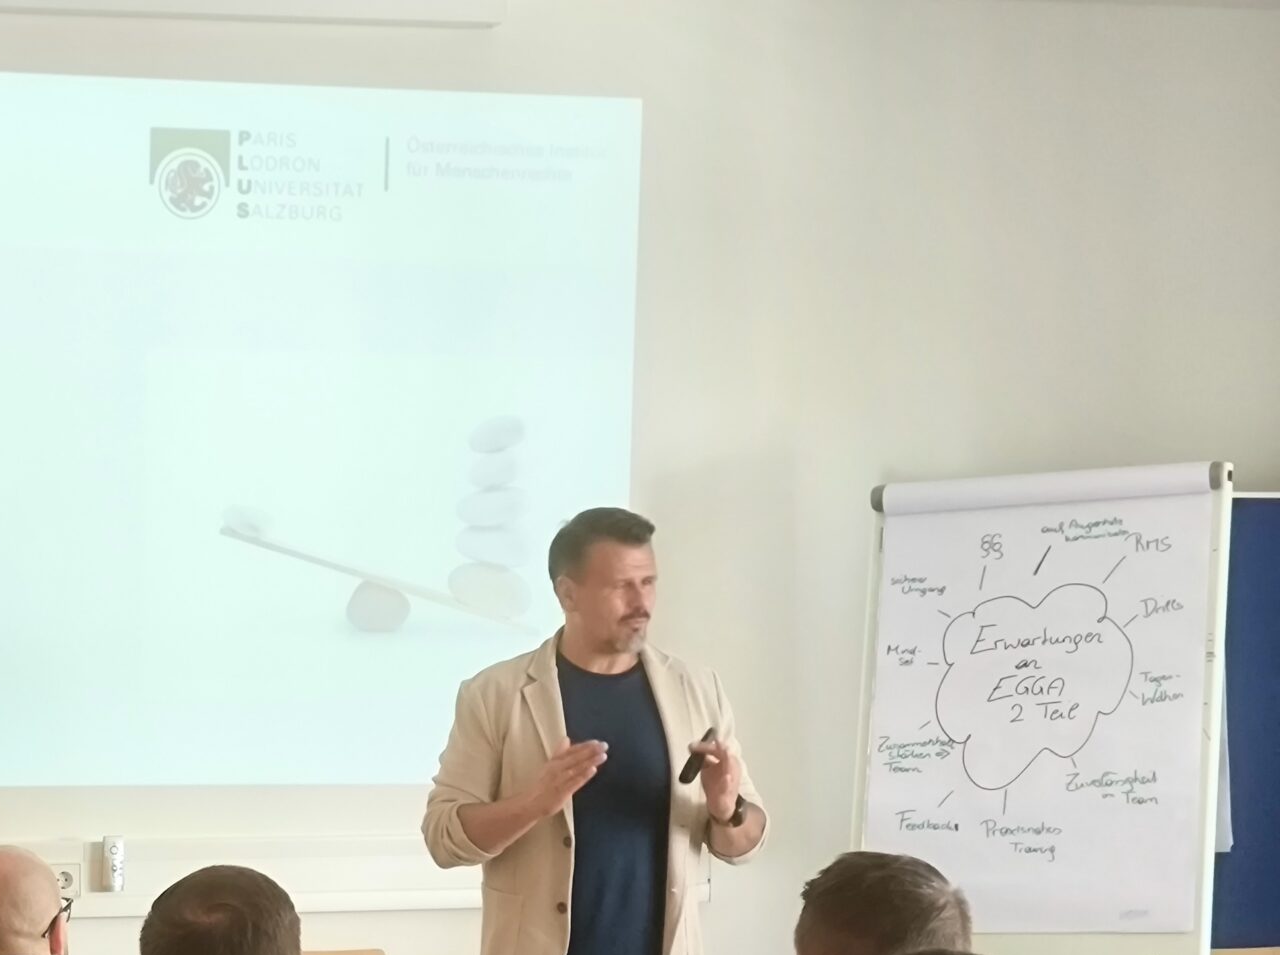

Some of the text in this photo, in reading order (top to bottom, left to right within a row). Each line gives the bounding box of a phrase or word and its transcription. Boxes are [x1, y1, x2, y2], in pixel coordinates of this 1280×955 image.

[237, 130, 298, 149] PARIS
[237, 154, 321, 173] LODRON
[406, 161, 428, 177] für
[236, 201, 343, 222] SALZBURG
[970, 624, 1104, 654] Erwartungen
[1015, 659, 1042, 670] an
[987, 674, 1065, 702] EGGA
[1010, 701, 1080, 723] 2 Teil
[883, 760, 923, 773] Team
[1121, 791, 1158, 805] Team
